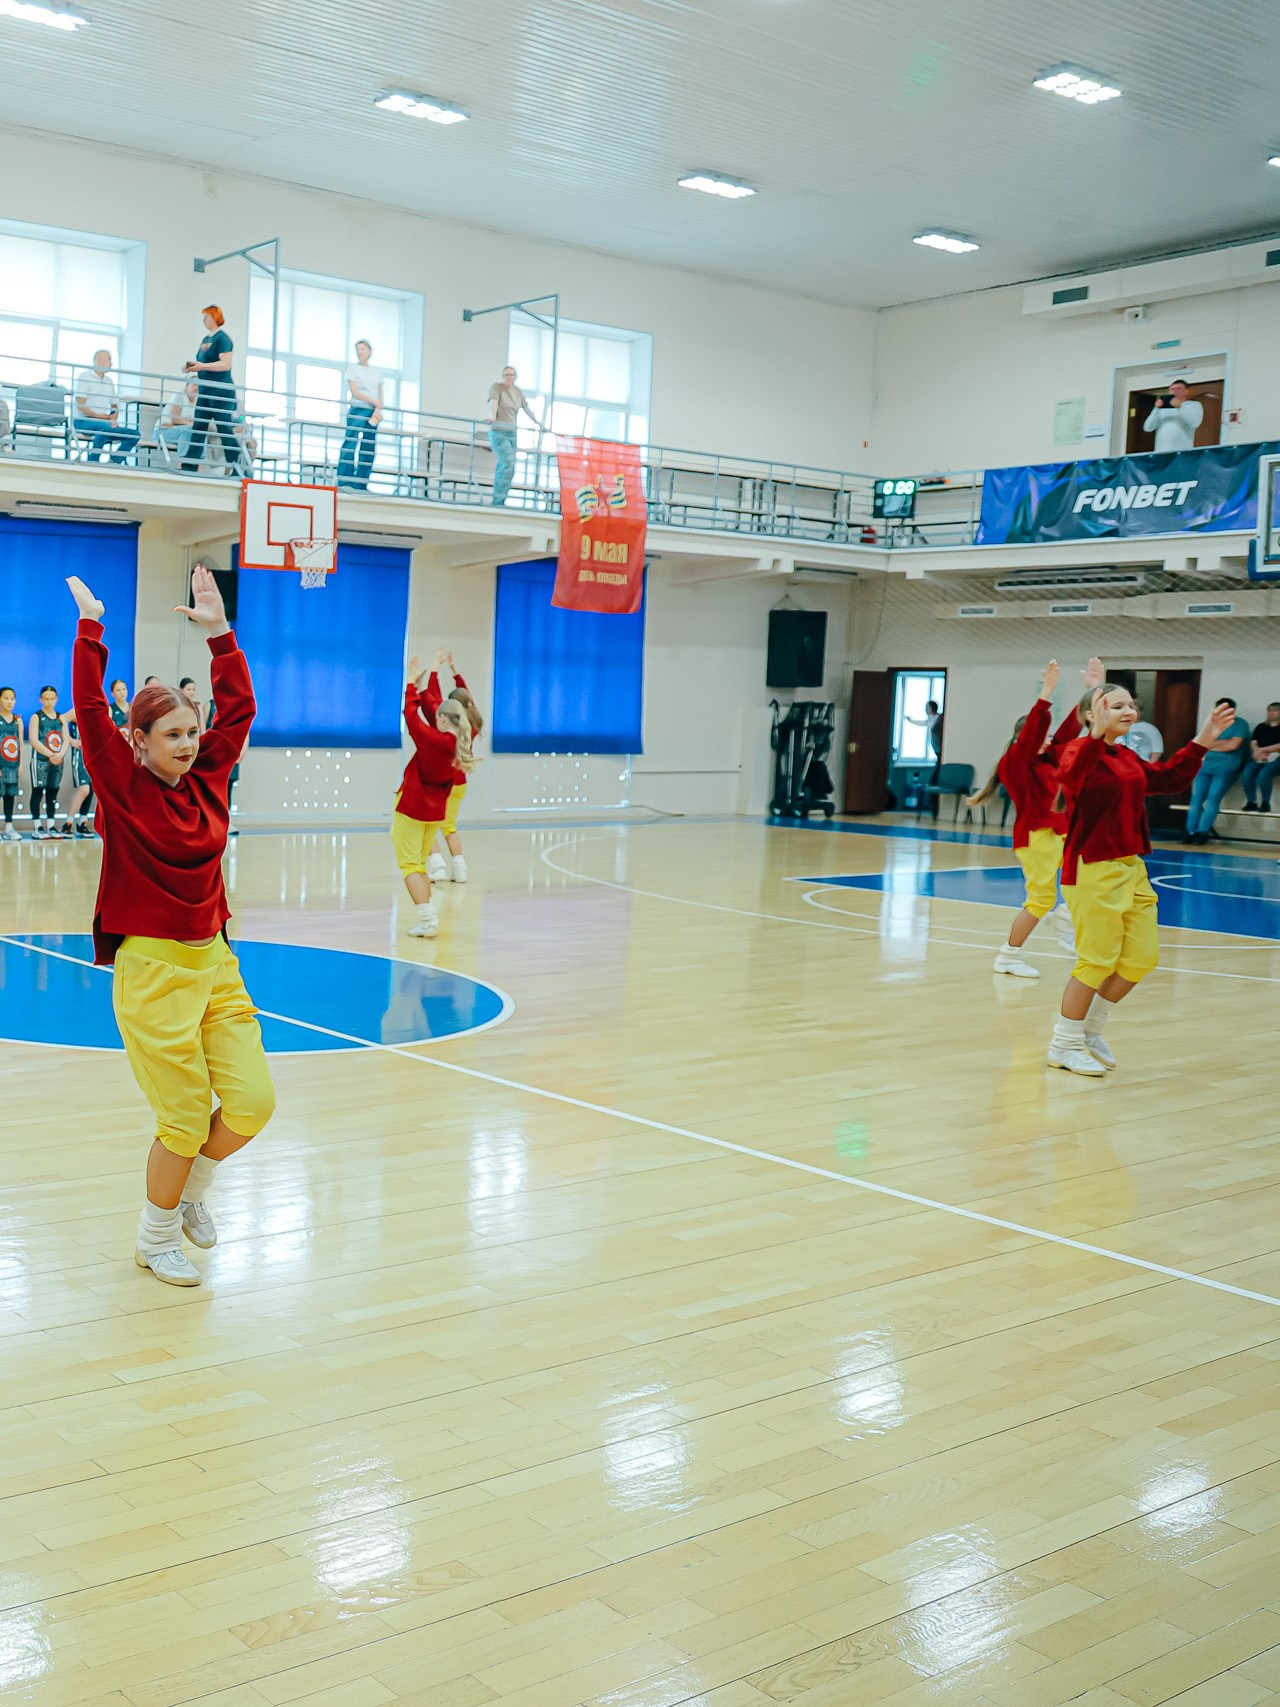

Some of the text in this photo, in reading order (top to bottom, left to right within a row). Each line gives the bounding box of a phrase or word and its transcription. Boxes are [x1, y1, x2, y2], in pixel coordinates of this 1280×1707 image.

[1072, 480, 1198, 514] FONBET
[580, 534, 628, 564] 9 мая
